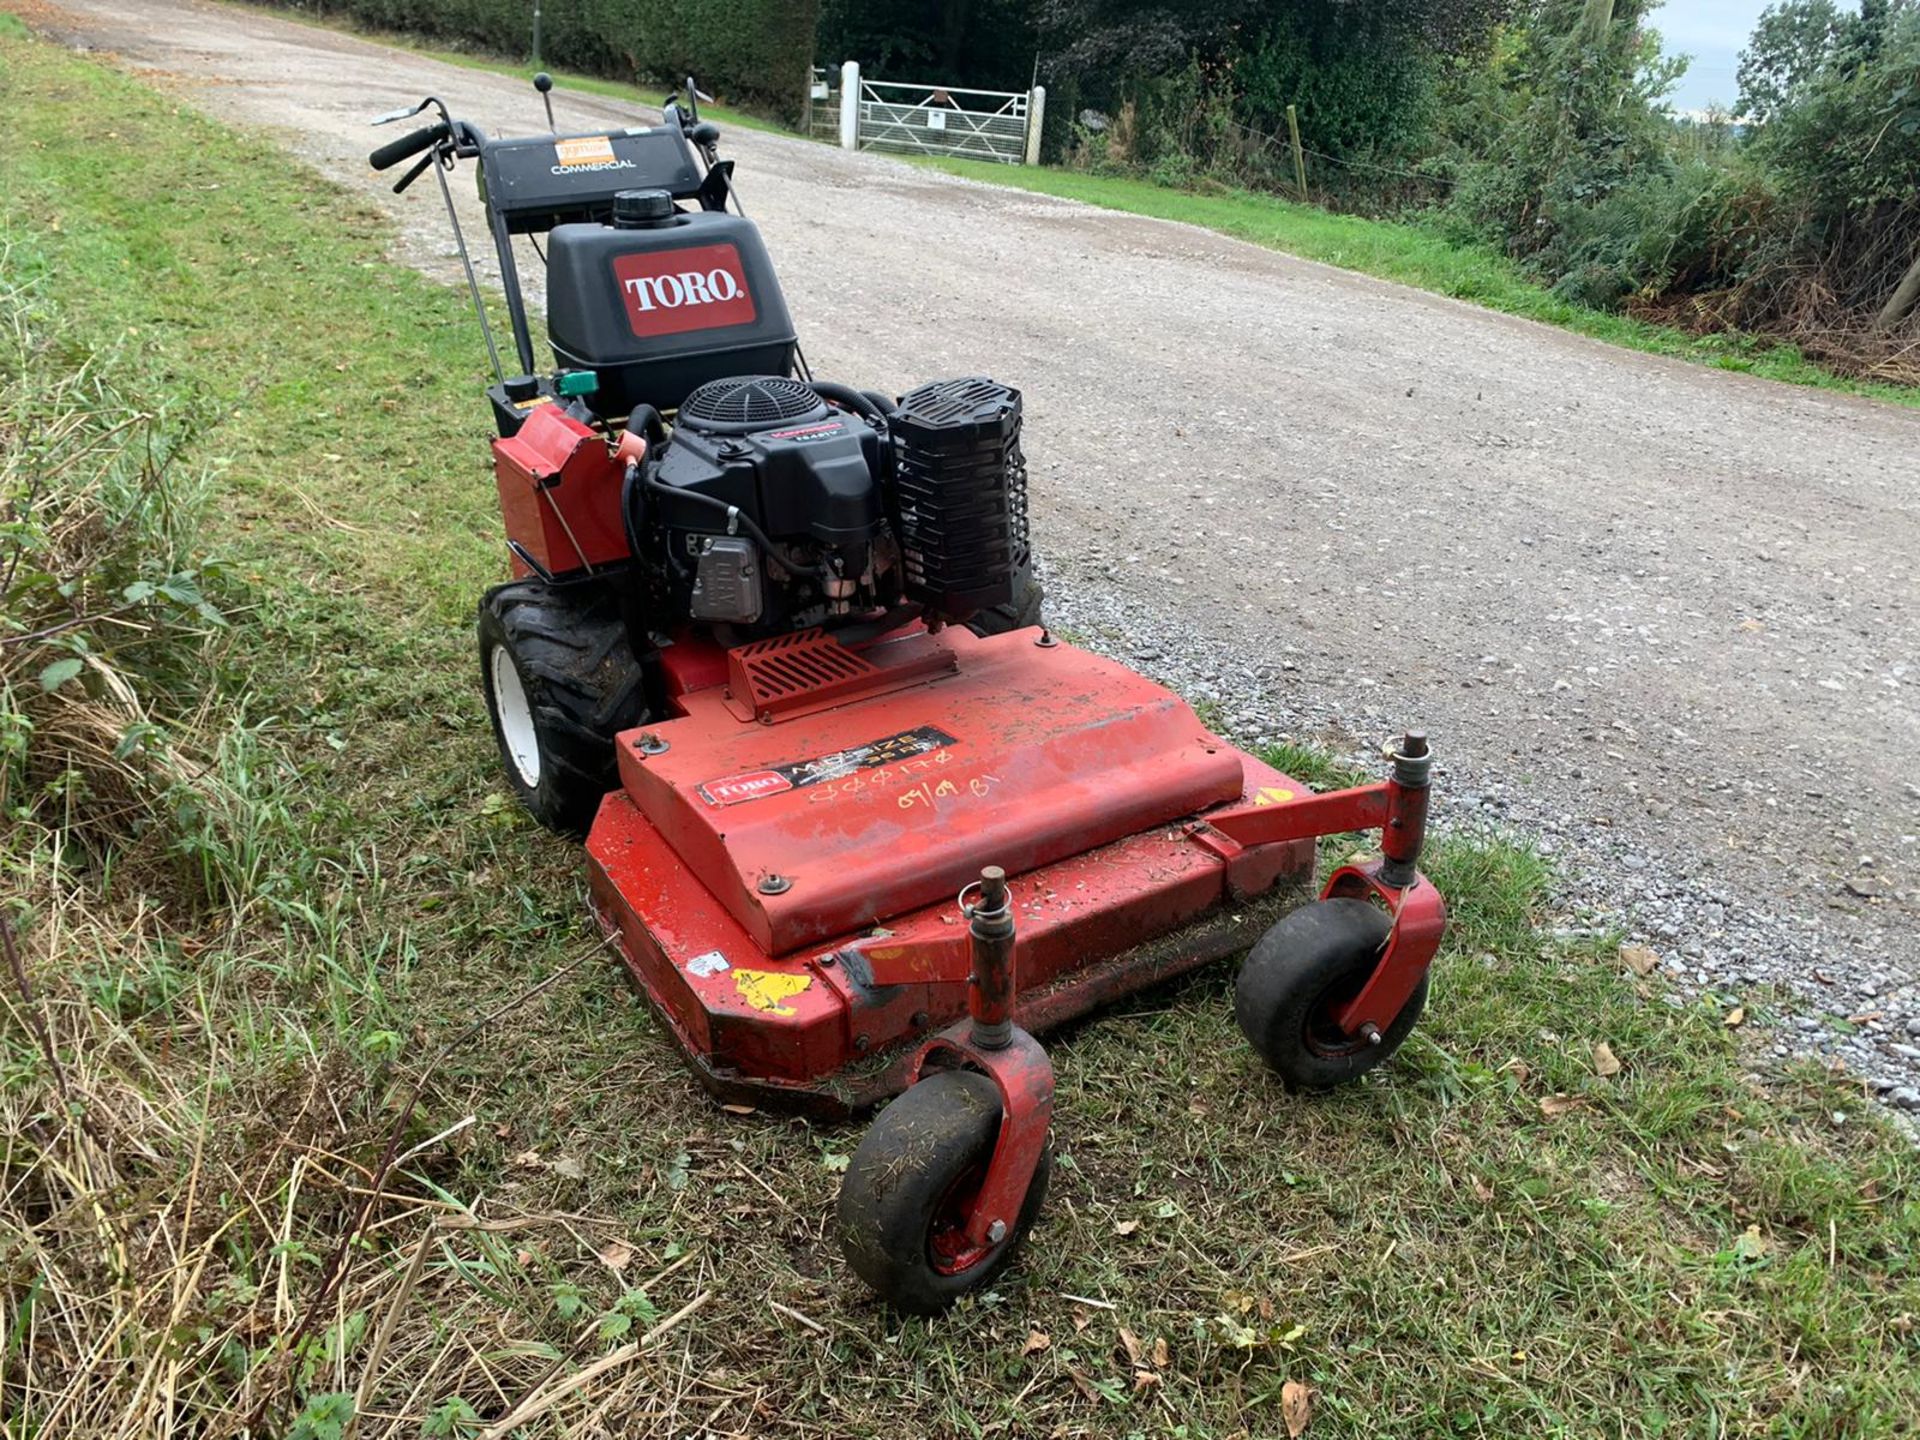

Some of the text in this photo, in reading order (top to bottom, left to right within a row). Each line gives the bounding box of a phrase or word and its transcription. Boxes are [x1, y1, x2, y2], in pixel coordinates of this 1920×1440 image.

[551, 160, 637, 175] COMMERCIAL
[624, 268, 737, 311] TORO
[714, 777, 780, 796] TORO
